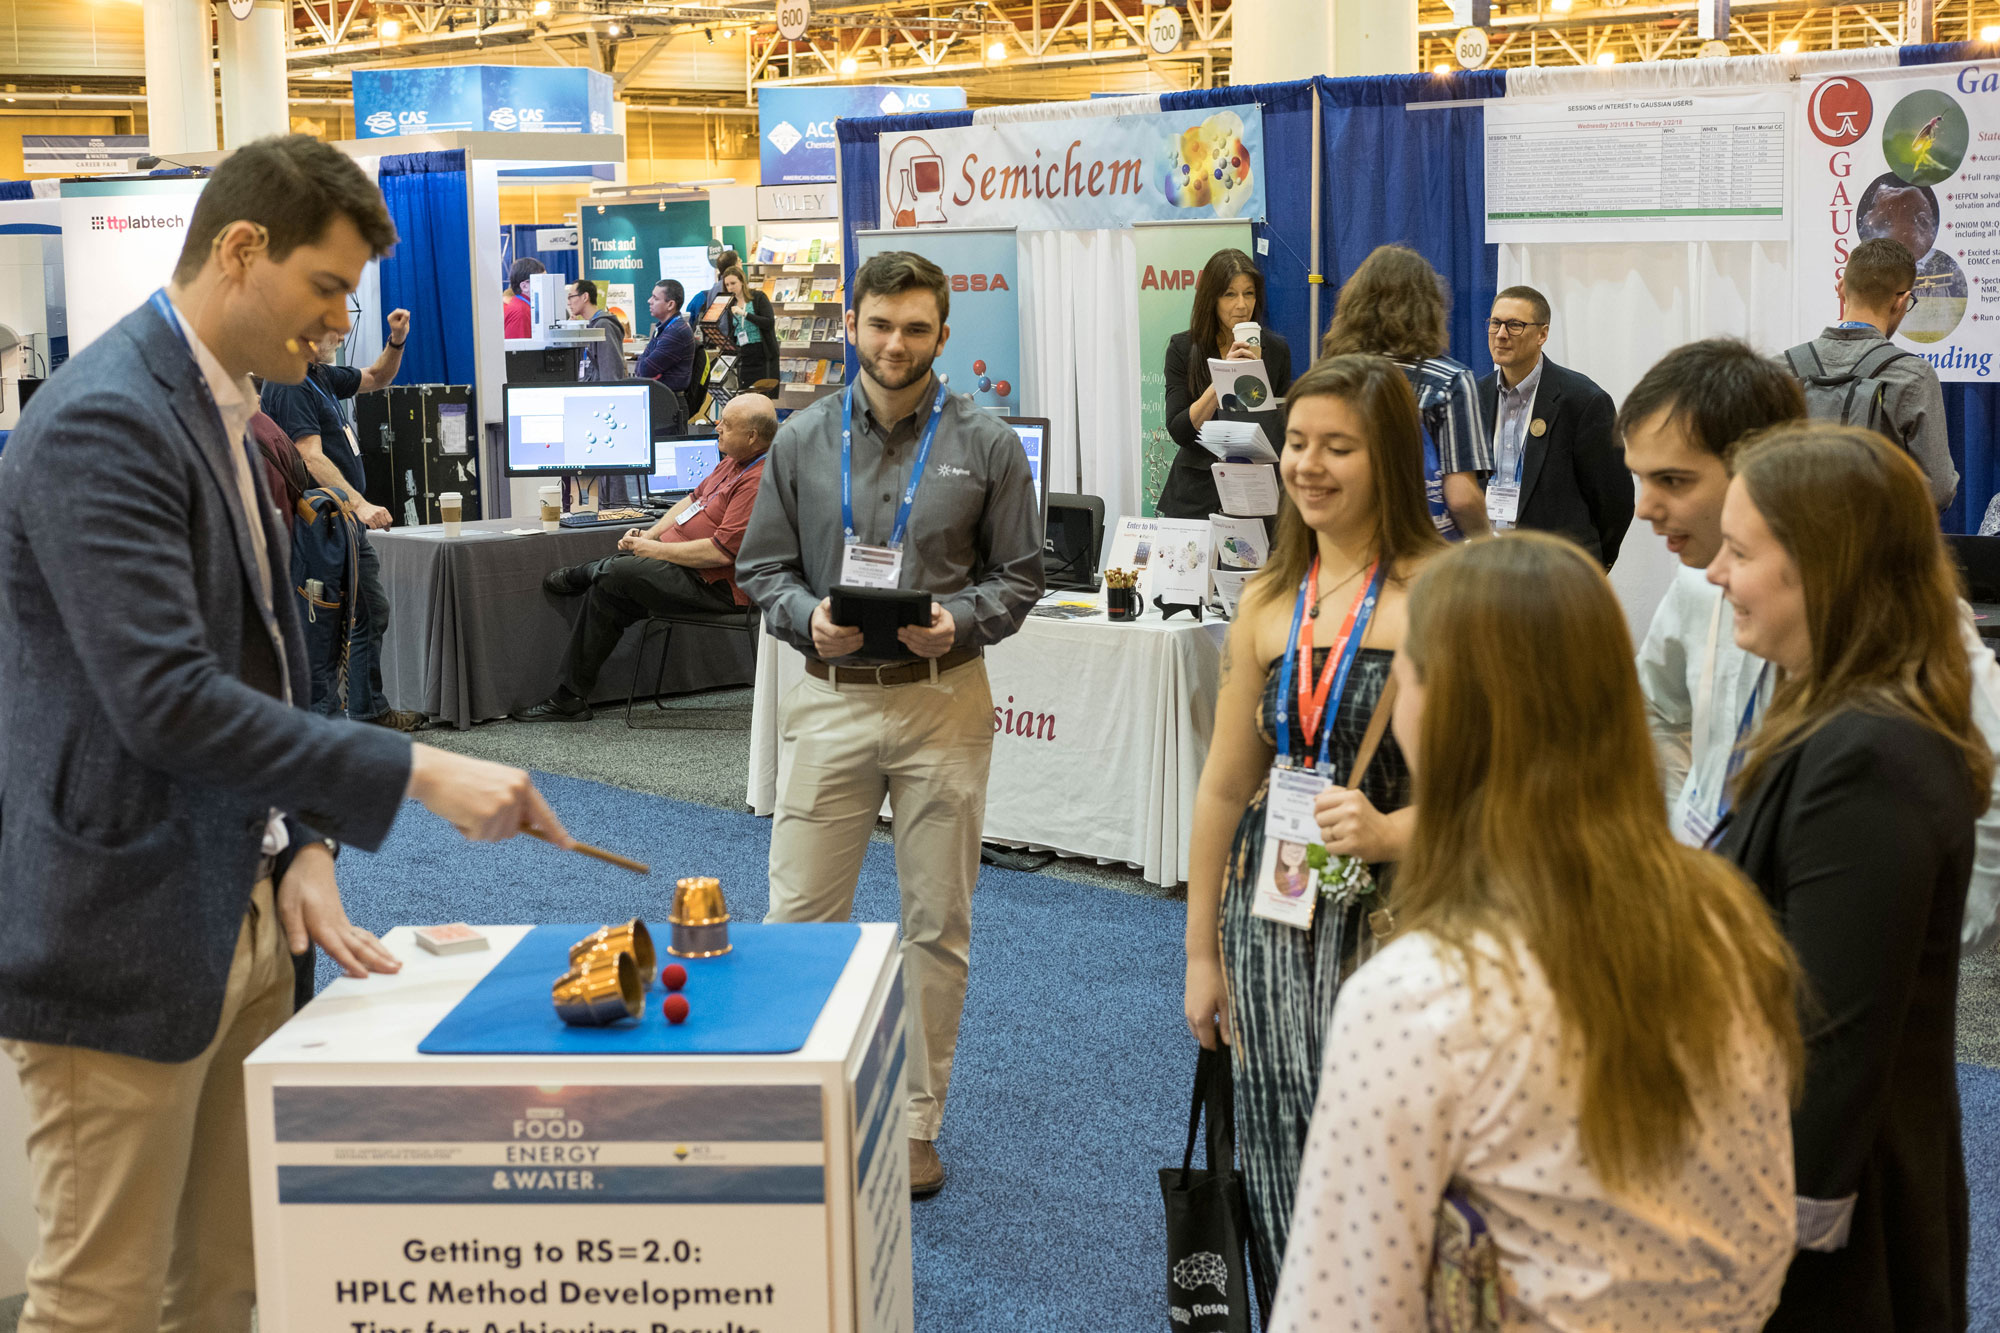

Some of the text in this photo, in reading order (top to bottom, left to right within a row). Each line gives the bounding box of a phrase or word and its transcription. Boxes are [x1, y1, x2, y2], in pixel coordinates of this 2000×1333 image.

[782, 7, 803, 27] 600
[1154, 24, 1176, 42] 700
[1460, 43, 1482, 58] 800
[1957, 66, 2000, 95] Ga
[906, 93, 931, 108] ACS
[1567, 104, 1597, 112] SESSIONS
[1604, 102, 1632, 110] INTEREST
[1640, 101, 1671, 109] GAUSSIAN
[399, 111, 428, 124] CAS
[519, 108, 545, 122] CAS
[805, 121, 836, 138] ACS
[1577, 122, 1608, 130] Wednesday
[1635, 120, 1662, 129] Thursday
[953, 140, 1143, 207] Semichem
[1968, 173, 1981, 181] Full
[772, 193, 824, 211] WILEY
[107, 214, 184, 232] ttplabtech
[1955, 229, 1996, 238] including all
[591, 237, 636, 251] Trust and
[1967, 248, 1990, 256] Excited
[592, 256, 643, 270] Innovation
[944, 273, 1009, 292] SSA
[1127, 521, 1142, 530] Enter
[512, 1119, 584, 1139] FOOD
[506, 1146, 600, 1163] ENERGY
[403, 1239, 702, 1270] Getting to RS=2.0:
[336, 1279, 775, 1311] HPLC Method Development
